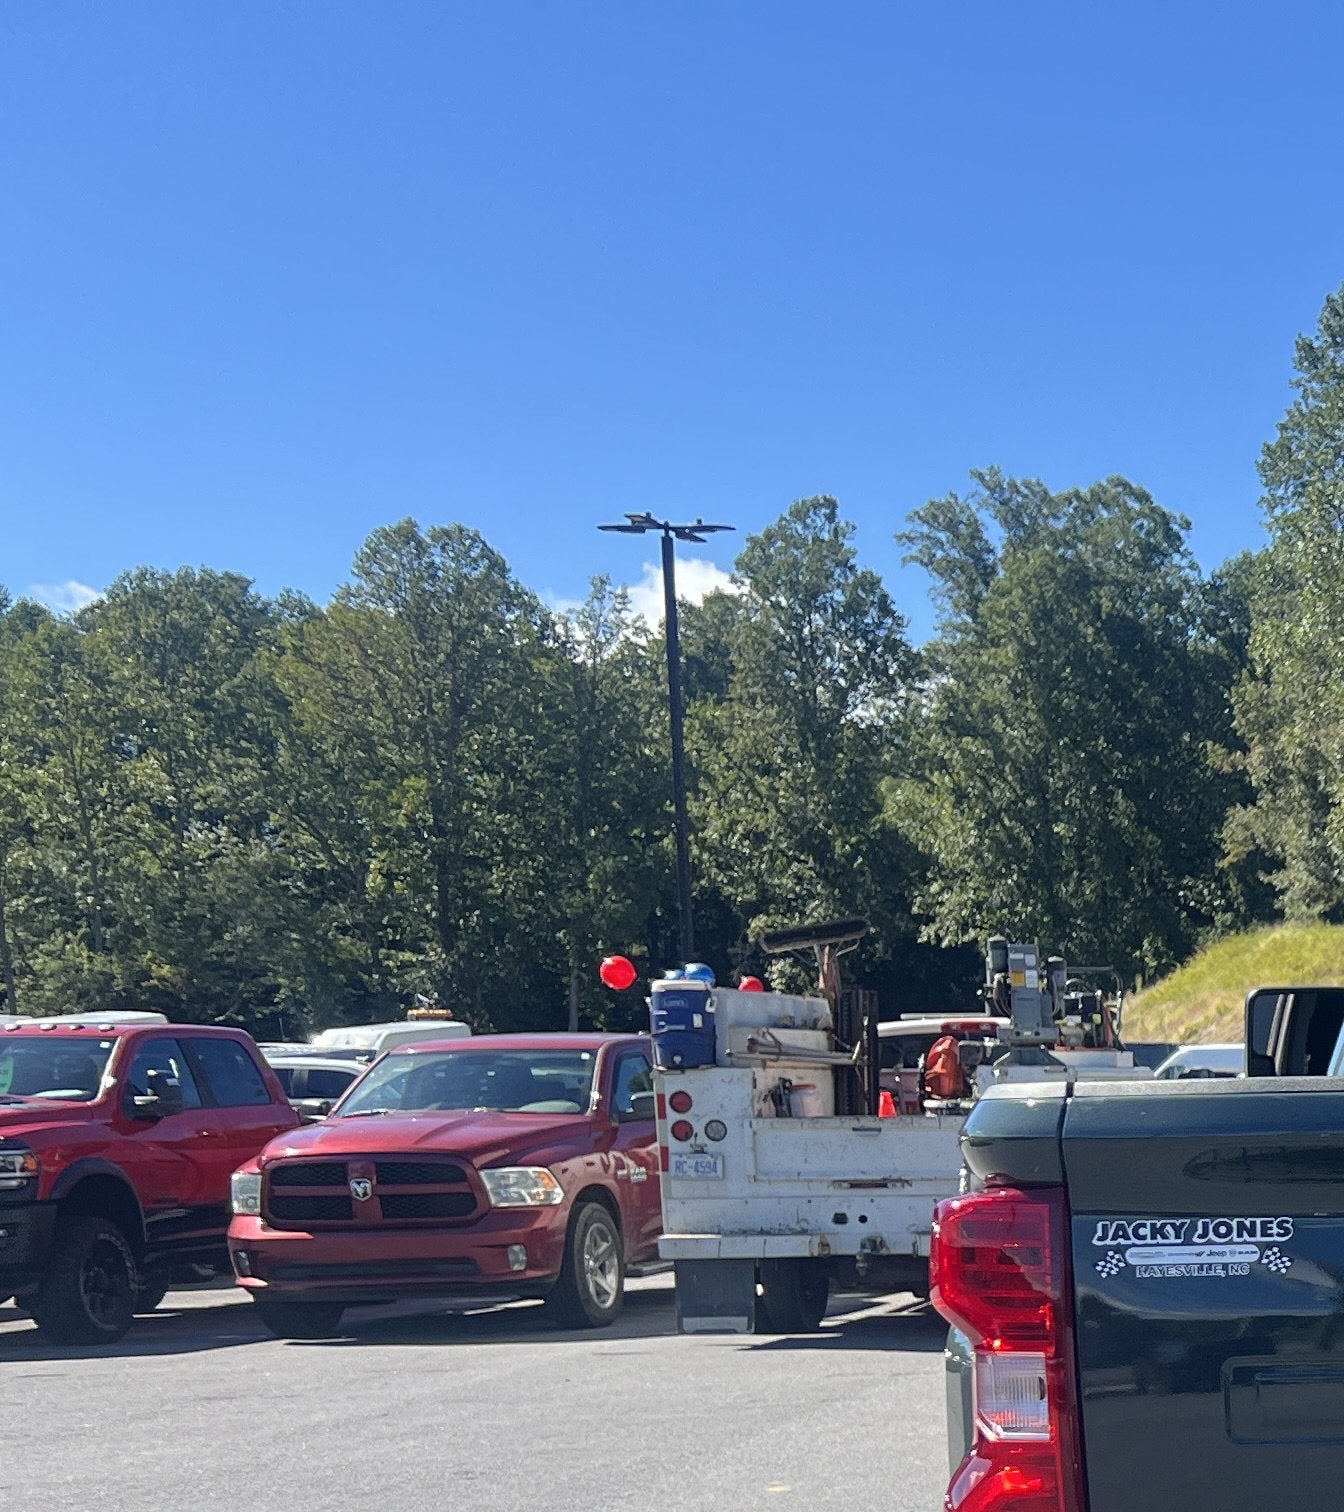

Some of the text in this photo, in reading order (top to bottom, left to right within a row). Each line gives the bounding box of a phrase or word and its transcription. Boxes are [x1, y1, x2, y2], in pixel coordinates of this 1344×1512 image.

[1092, 1217, 1293, 1245] JACKY JONES
[1136, 1263, 1251, 1278] HAYESVILLE, NC
